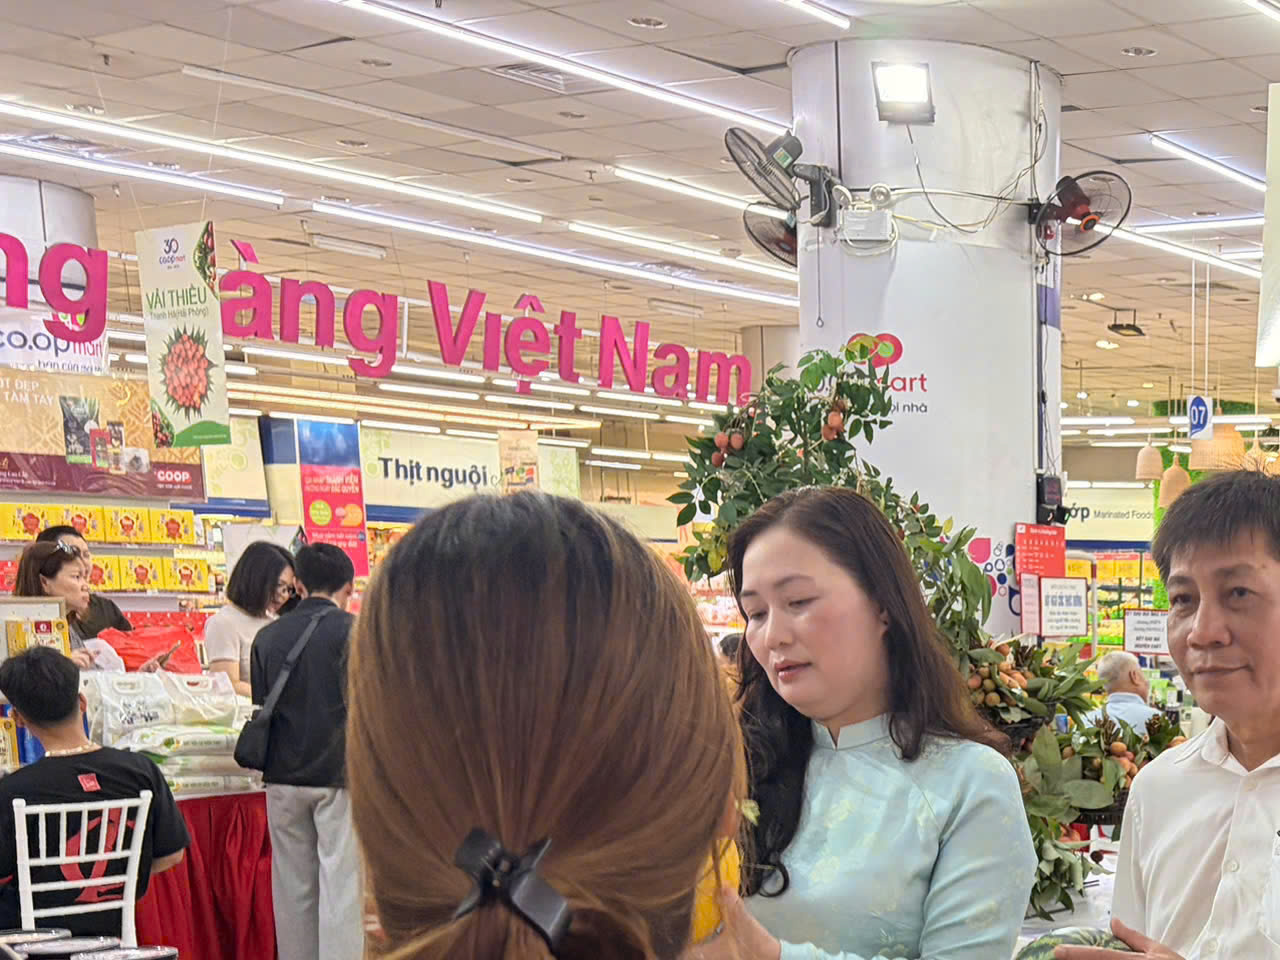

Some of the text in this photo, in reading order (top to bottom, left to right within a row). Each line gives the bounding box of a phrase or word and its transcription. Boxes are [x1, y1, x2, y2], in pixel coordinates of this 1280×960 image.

[145, 283, 208, 310] VẢI THIỀU
[218, 238, 398, 378] àng
[427, 279, 583, 395] Việt
[599, 314, 752, 406] Nam
[1191, 406, 1206, 425] 07
[378, 457, 488, 489] Thịt nguội
